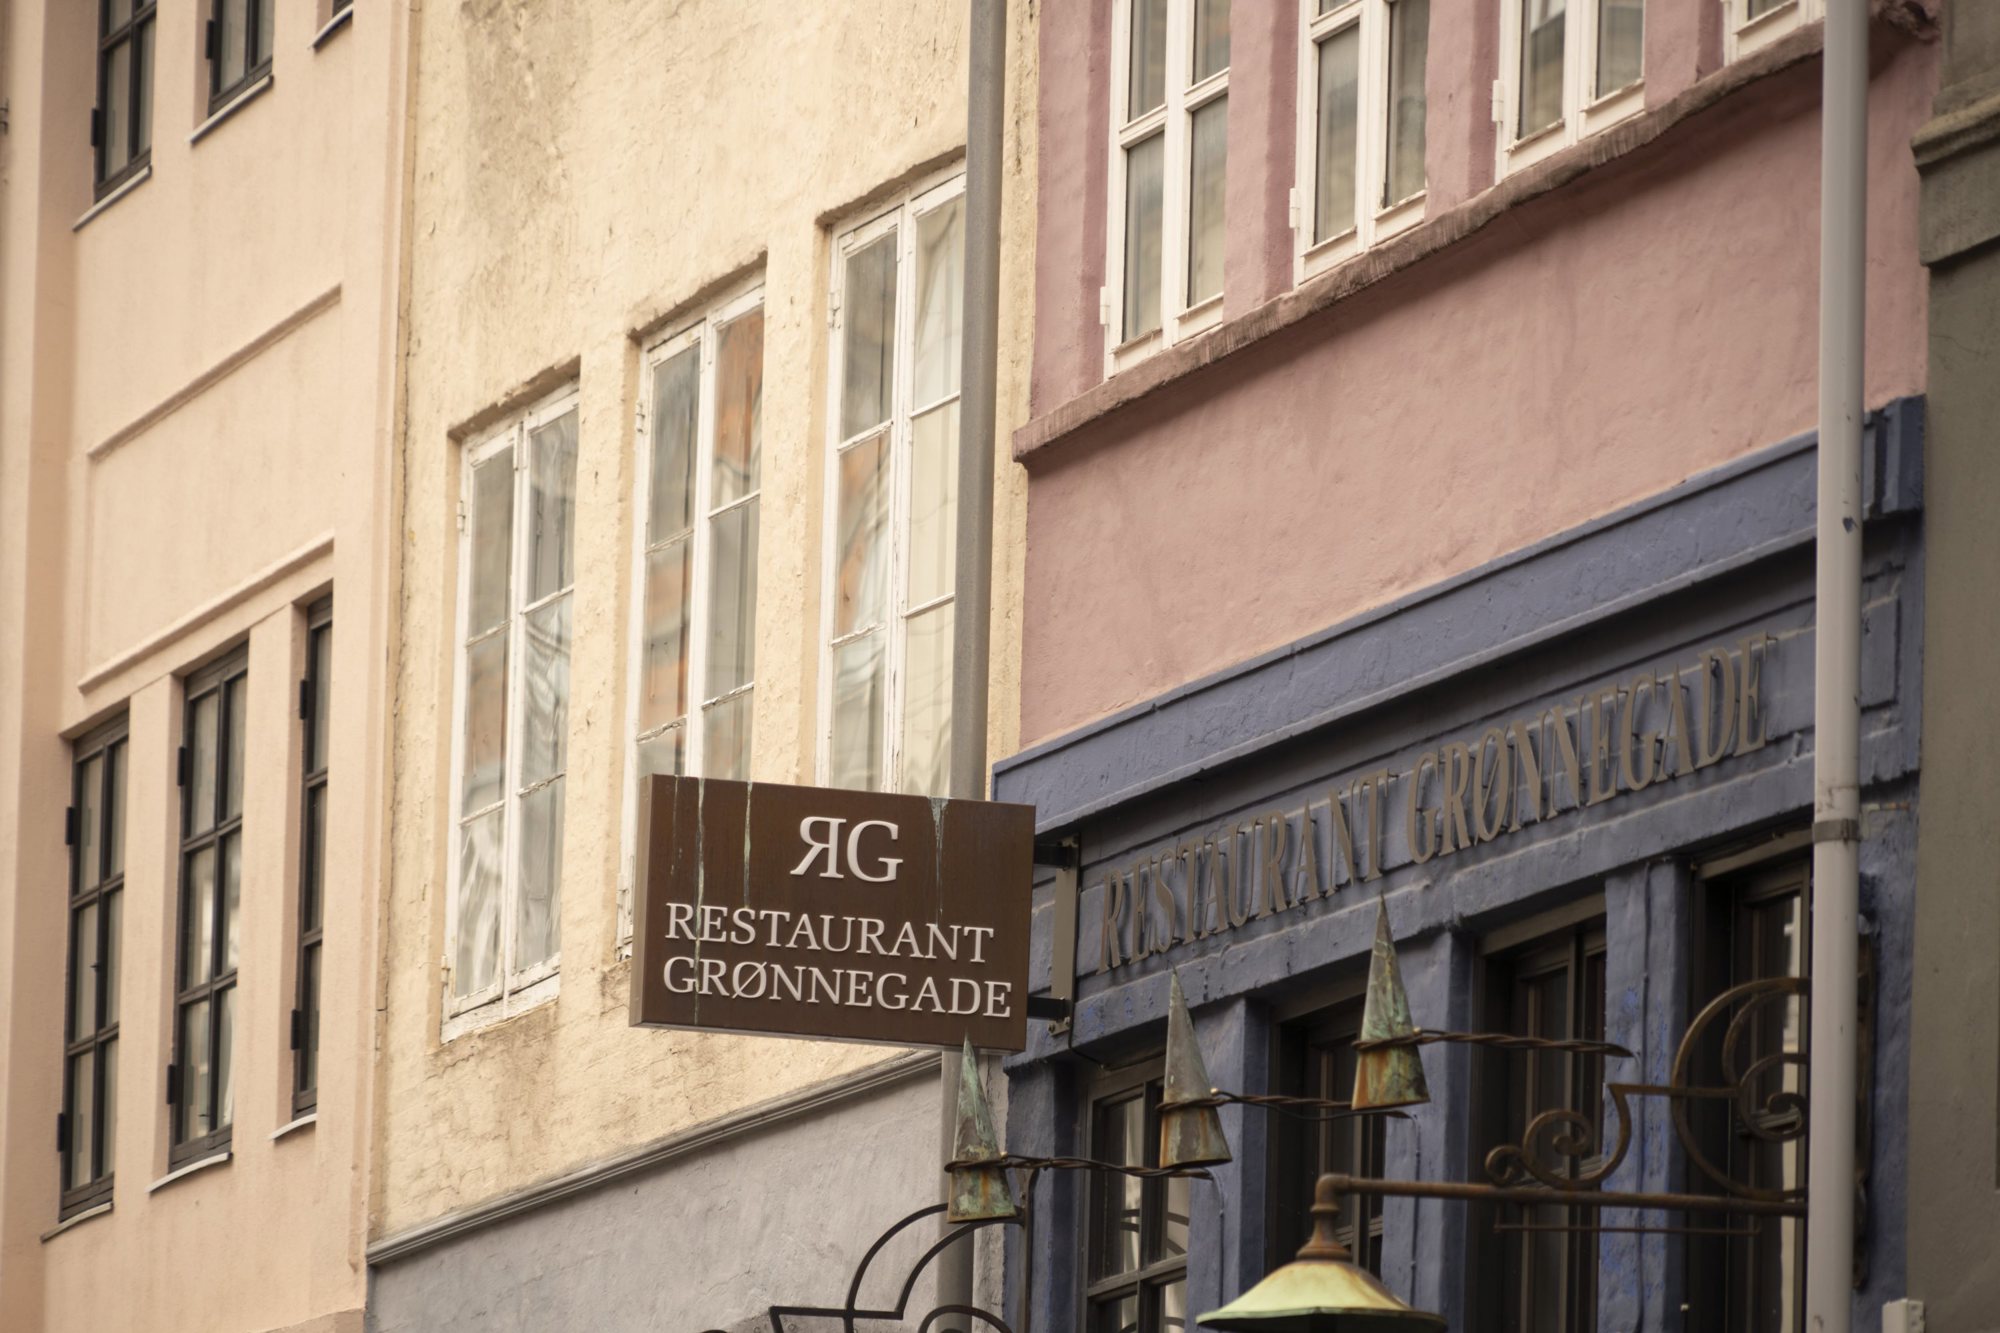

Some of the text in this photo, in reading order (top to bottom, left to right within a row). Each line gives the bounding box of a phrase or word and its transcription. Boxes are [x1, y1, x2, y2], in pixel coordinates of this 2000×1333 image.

[1096, 631, 1769, 976] RESTAURANT GRØNNEGADE
[665, 902, 994, 963] RESTAURANT
[663, 956, 1012, 1018] GRØNNEGADE
